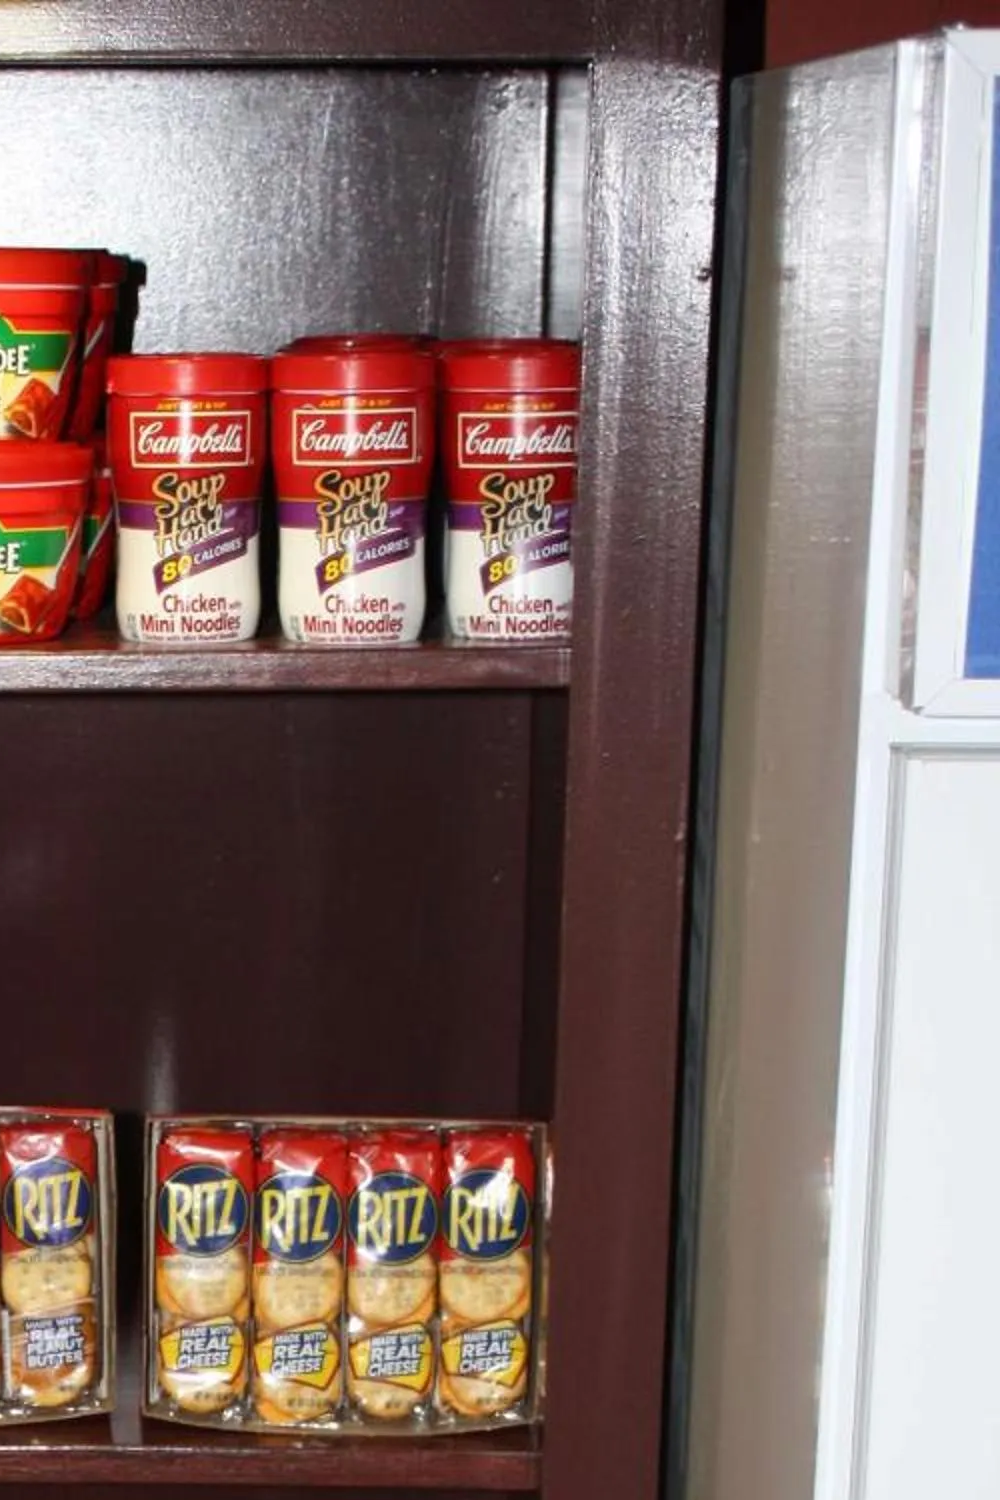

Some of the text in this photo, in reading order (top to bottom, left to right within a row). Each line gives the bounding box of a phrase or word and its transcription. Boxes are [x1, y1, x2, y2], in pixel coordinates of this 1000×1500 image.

[138, 420, 243, 462] Campbell's
[301, 418, 409, 459] Campbell's
[465, 421, 573, 461] Campbell's
[152, 471, 227, 518] Soup
[314, 469, 391, 517] Soup
[479, 471, 555, 518] Soup
[181, 497, 211, 523] at
[343, 497, 374, 523] at
[507, 498, 536, 524] at
[154, 504, 224, 557] Hand
[316, 503, 389, 556] Hand
[480, 504, 553, 557] Hand
[162, 537, 244, 583] 80 CALORIES
[324, 535, 411, 582] 80 CALORIES
[488, 540, 570, 583] 80 ALORIE
[162, 593, 227, 613] Chicken
[325, 593, 389, 614] Chicken
[488, 594, 553, 614] Chicken
[139, 611, 241, 634] Mini Noodles
[303, 612, 404, 635] Mini Noodles
[469, 612, 570, 635] Mini Noodles
[13, 1169, 83, 1241] RITZ
[166, 1178, 237, 1246] RITZ
[449, 1183, 520, 1252] RITZ
[262, 1184, 331, 1253] RITZ
[357, 1185, 427, 1255] RITZ
[29, 1327, 79, 1343] REAL
[180, 1336, 231, 1351] REAL
[27, 1353, 84, 1369] BUTTER
[177, 1351, 230, 1368] CHEESE
[274, 1343, 325, 1358] REAL
[370, 1343, 421, 1361] REAL
[461, 1340, 512, 1357] REAL
[272, 1357, 324, 1375] CHEESE
[368, 1358, 420, 1376] CHEESE
[459, 1354, 512, 1373] CHEESE
